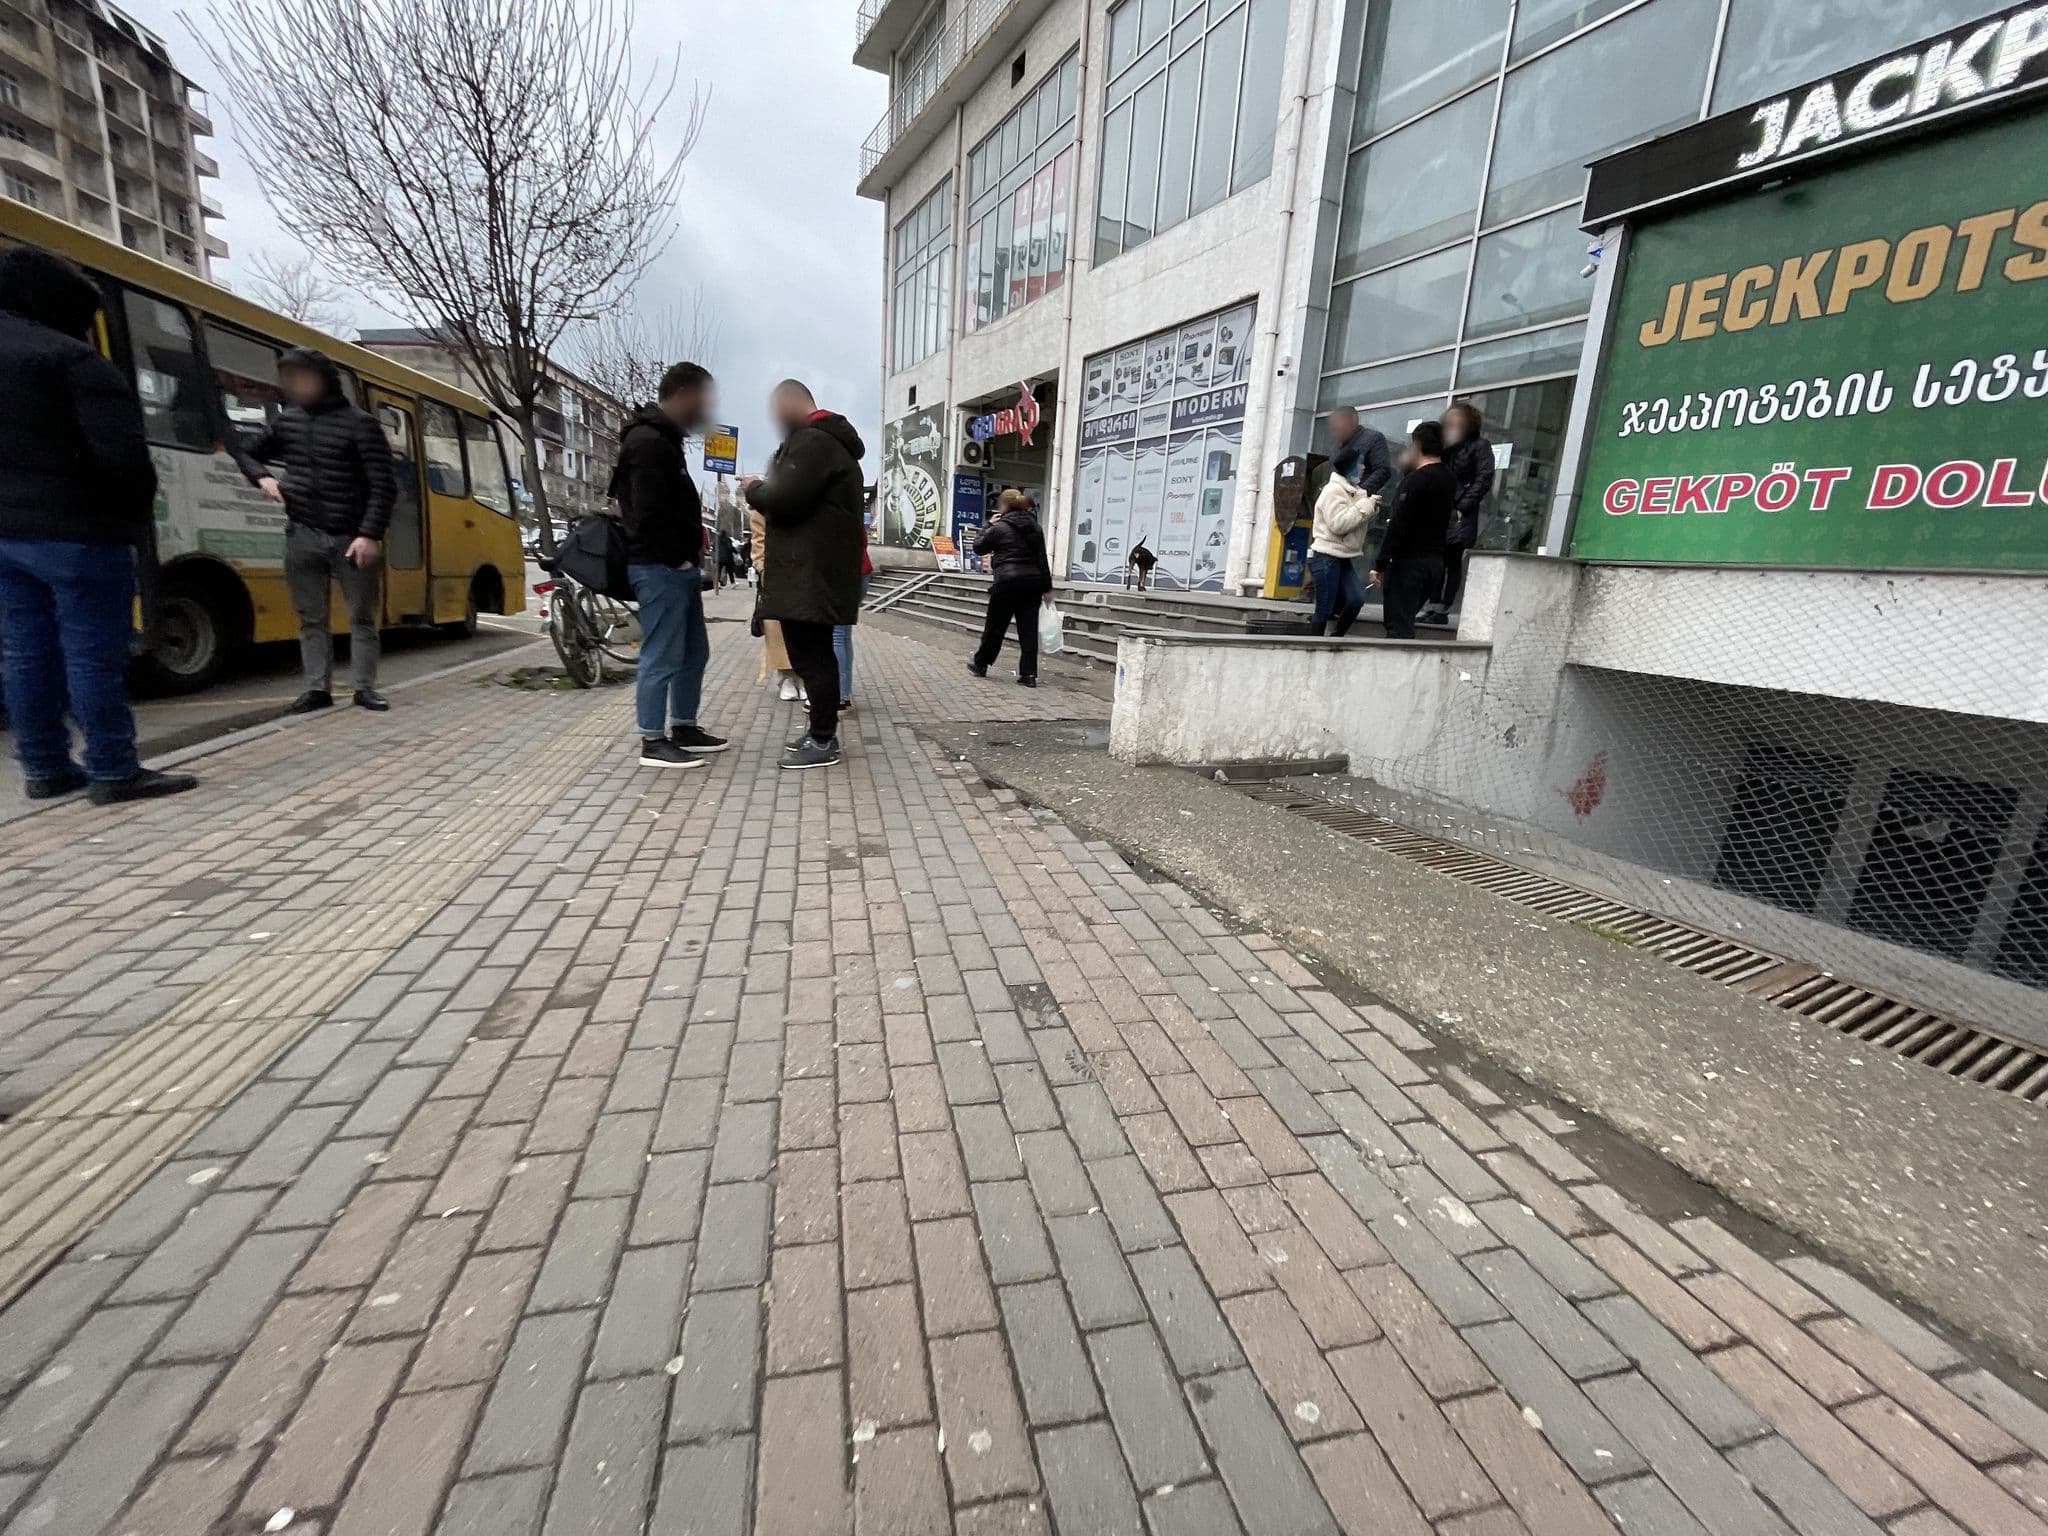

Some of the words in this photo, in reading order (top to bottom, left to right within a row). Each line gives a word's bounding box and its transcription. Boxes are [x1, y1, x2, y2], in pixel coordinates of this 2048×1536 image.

[1638, 199, 2048, 348] JECKPOTS
[1175, 385, 1246, 418] MODERN
[1618, 369, 1894, 437] ჯეკპოტების
[1171, 475, 1194, 484] SONY
[1603, 462, 1852, 515] GEKPÖT
[1865, 457, 2048, 510] DOL
